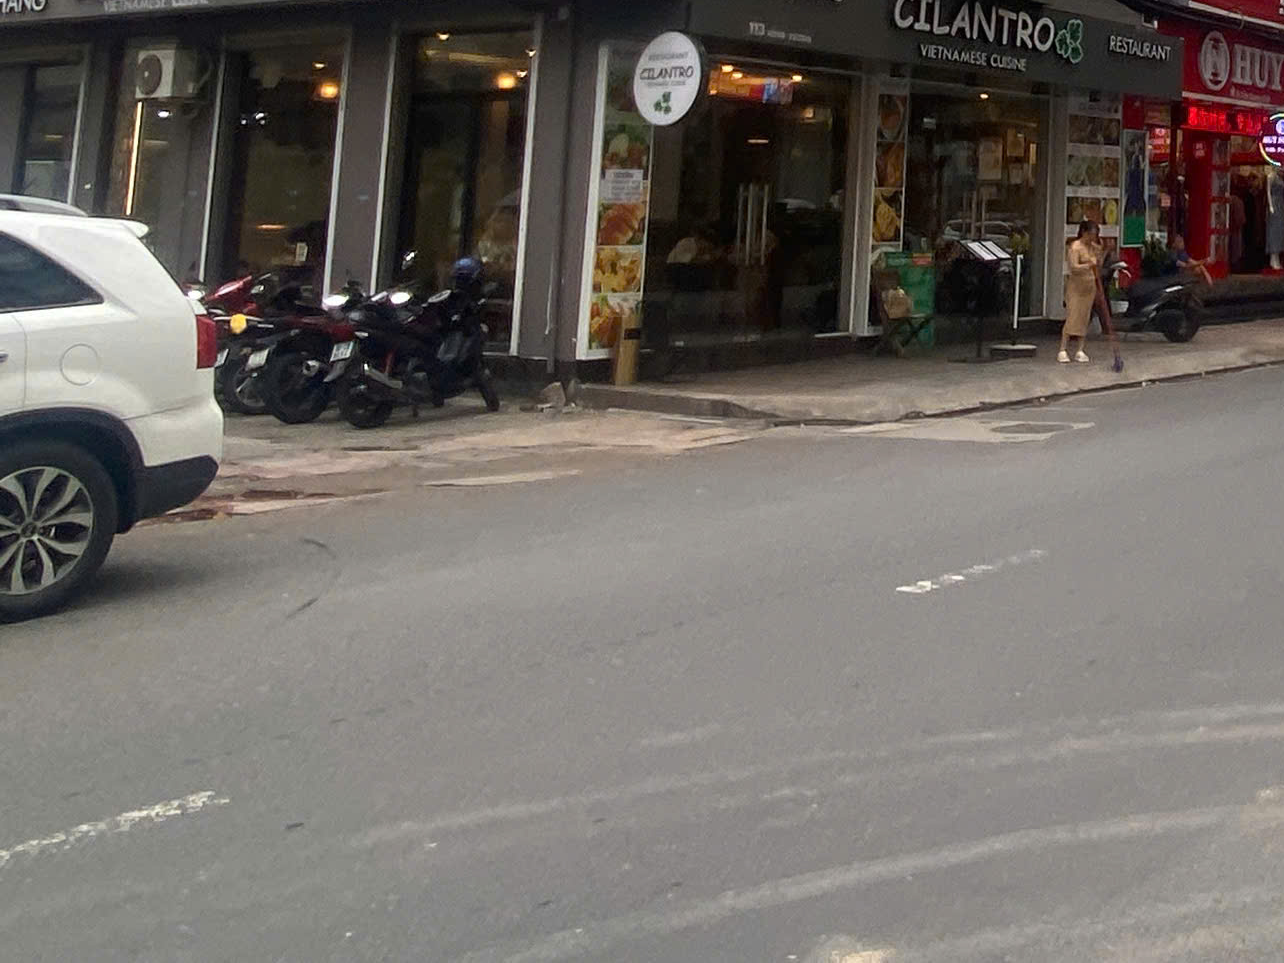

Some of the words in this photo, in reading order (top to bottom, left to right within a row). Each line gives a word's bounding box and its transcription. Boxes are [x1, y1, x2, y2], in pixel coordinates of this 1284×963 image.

[920, 44, 987, 66] VIETNAMESE
[990, 53, 1027, 72] CUISINE
[1109, 35, 1171, 61] RESTAURANT
[639, 65, 694, 80] CILANTRO
